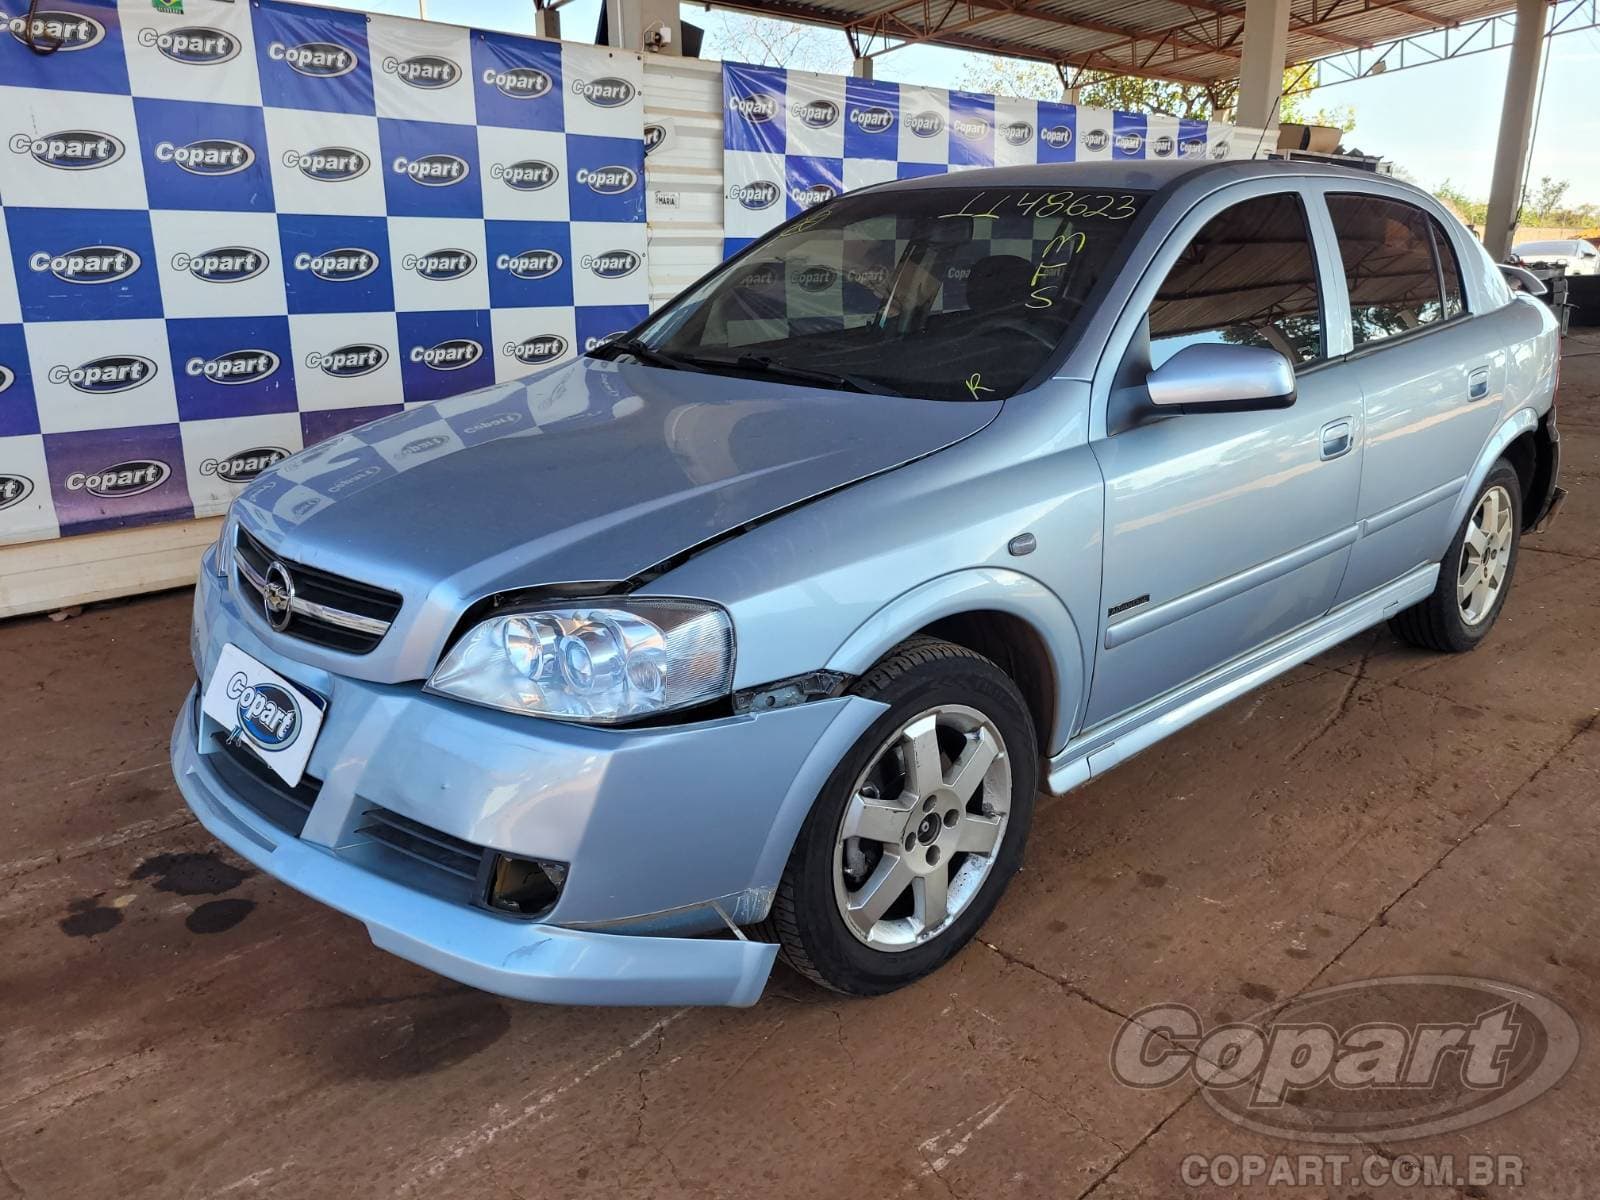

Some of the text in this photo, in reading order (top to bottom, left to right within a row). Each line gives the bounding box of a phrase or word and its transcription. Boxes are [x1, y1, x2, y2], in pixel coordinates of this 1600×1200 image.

[138, 27, 226, 56] Copart
[269, 42, 347, 67] Copart
[382, 57, 450, 79] Copart
[483, 69, 543, 90] Copart
[572, 79, 626, 100] Copart
[729, 97, 773, 117] Copart
[791, 103, 833, 121] Copart
[850, 109, 890, 127] Copart
[904, 114, 939, 131] Copart
[954, 118, 986, 136] Copart
[1041, 127, 1069, 142] Copart
[1115, 135, 1139, 150] Copart
[9, 134, 109, 160] Copart
[155, 143, 243, 168] Copart
[282, 150, 358, 171] Copart
[393, 156, 460, 177] Copart
[490, 163, 550, 182] Copart
[576, 169, 629, 188] Copart
[730, 184, 773, 205] Copart
[791, 188, 832, 204] Copart
[29, 251, 128, 277] Copart
[171, 252, 257, 275] Copart
[294, 253, 369, 274] Copart
[402, 253, 467, 272] Copart
[496, 253, 554, 273] Copart
[581, 254, 632, 271] Copart
[410, 342, 474, 364] Copart
[503, 337, 560, 358] Copart
[186, 353, 269, 378] Copart
[305, 349, 377, 370] Copart
[49, 361, 143, 387] Copart
[200, 452, 280, 476] Copart
[66, 463, 159, 490] Copart
[227, 671, 297, 740] Copart
